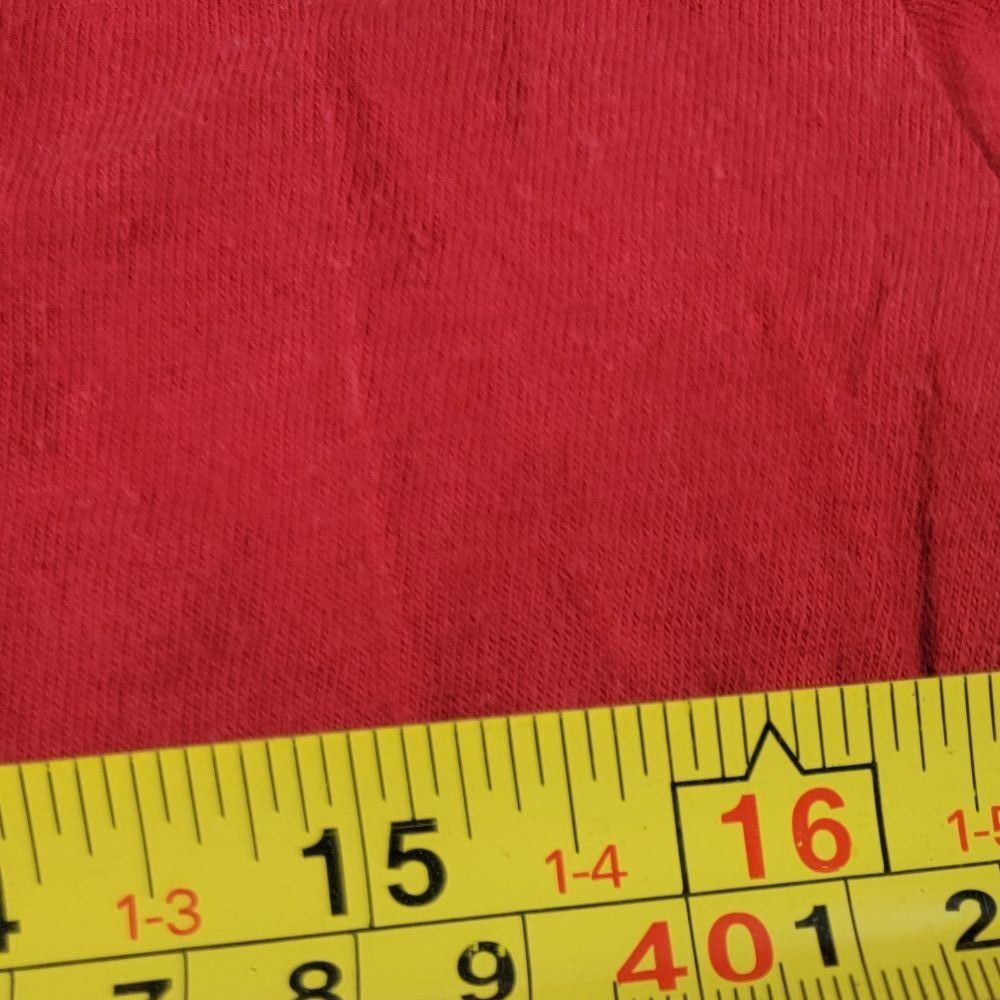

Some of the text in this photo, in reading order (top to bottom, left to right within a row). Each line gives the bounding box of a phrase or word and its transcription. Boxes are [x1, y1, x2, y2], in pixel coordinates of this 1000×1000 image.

[116, 888, 203, 941] 1-3
[302, 818, 448, 916] 15
[544, 844, 628, 894] 1-4
[720, 786, 853, 880] 16
[616, 911, 775, 992] 40
[795, 904, 840, 967] 1
